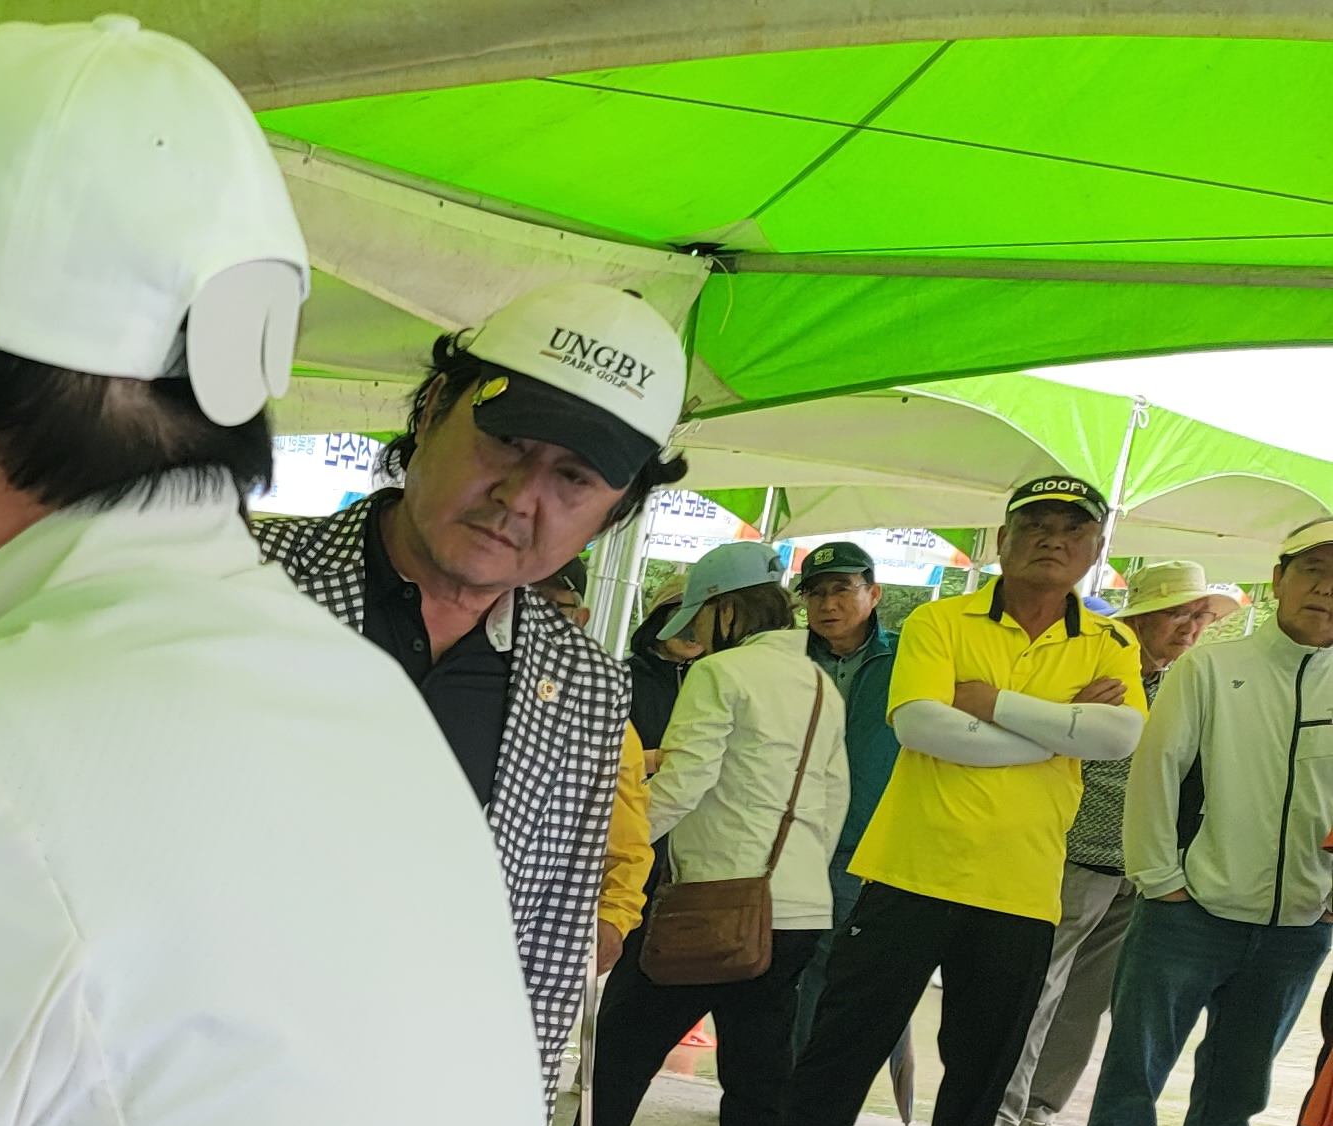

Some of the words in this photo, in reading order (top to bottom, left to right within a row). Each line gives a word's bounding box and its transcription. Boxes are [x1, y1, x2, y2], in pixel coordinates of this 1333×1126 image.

[550, 327, 655, 389] UNGBY
[561, 355, 594, 374] PARK
[1031, 479, 1089, 496] GOOFY
